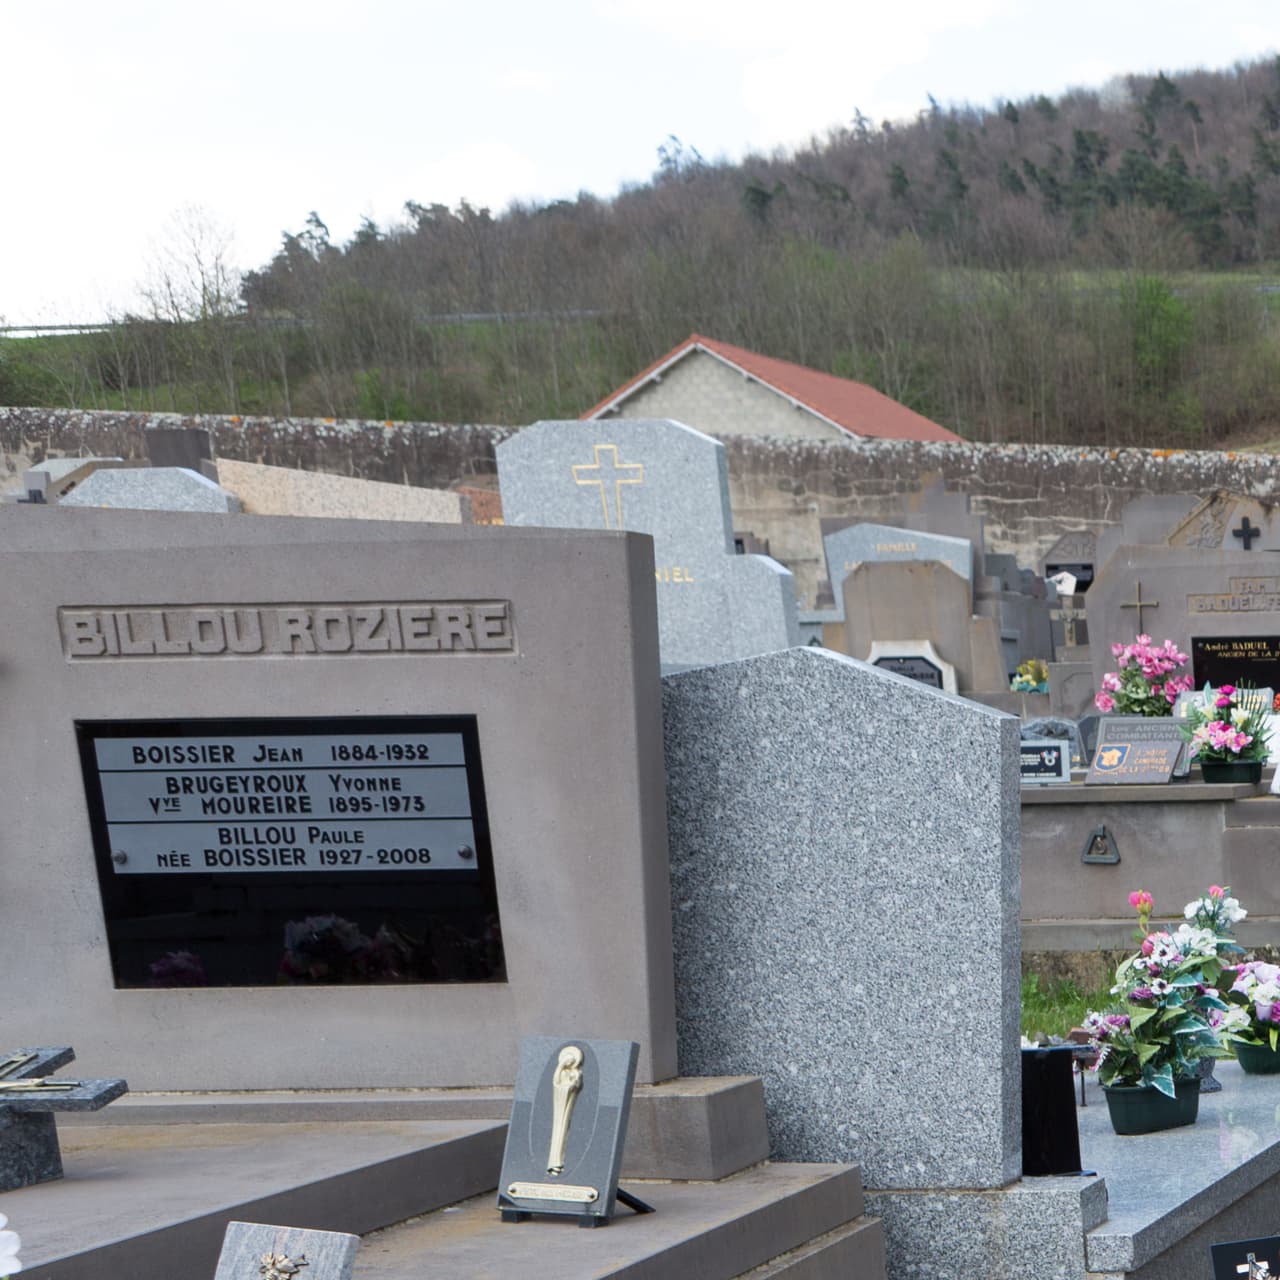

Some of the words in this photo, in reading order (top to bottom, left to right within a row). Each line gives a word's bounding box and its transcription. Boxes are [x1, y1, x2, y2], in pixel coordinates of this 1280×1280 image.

[69, 611, 264, 656] BILLOU
[283, 605, 514, 655] ROZIERE
[132, 745, 235, 764] BOISSIER
[331, 743, 430, 762] 1884-1932
[166, 774, 307, 795] BRUGEYROUX
[202, 796, 312, 816] MOUREIRE
[218, 826, 296, 846] BILLOU
[204, 847, 306, 868] BOISSIER
